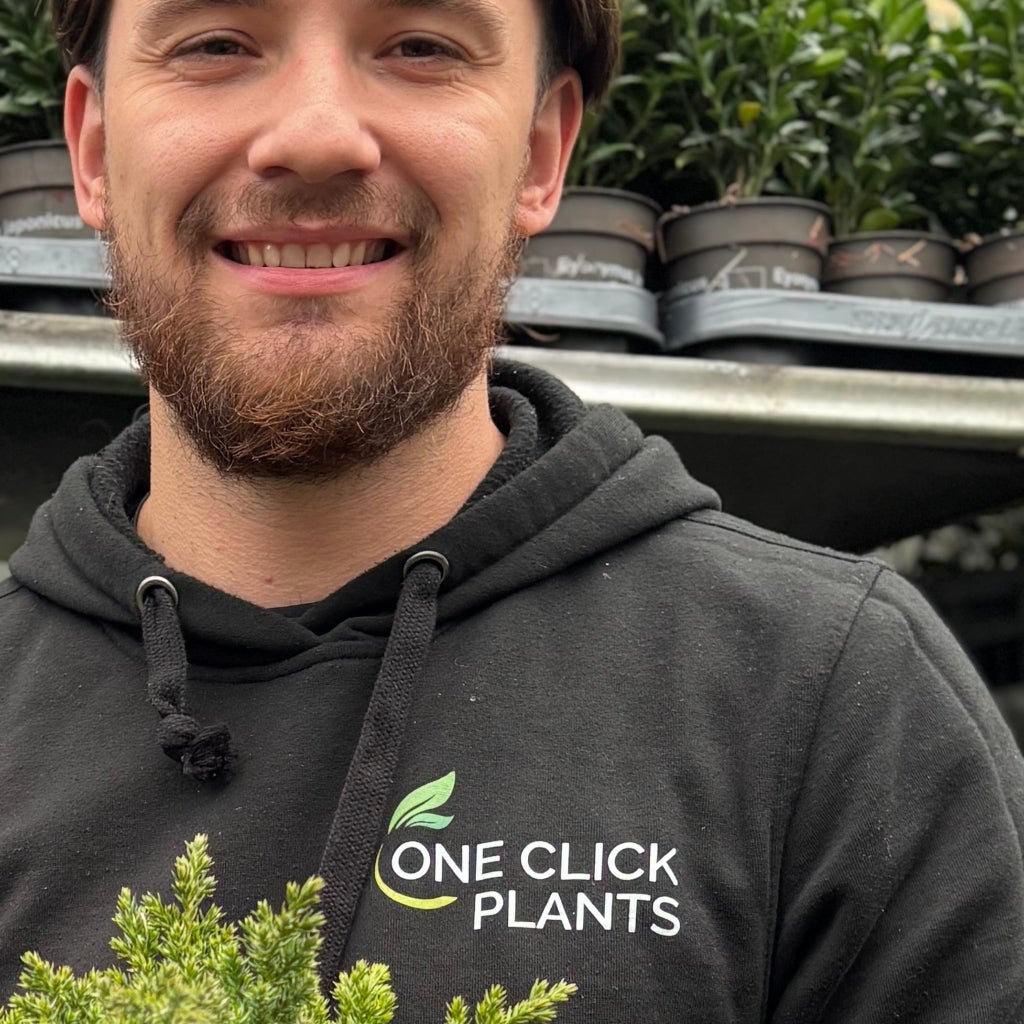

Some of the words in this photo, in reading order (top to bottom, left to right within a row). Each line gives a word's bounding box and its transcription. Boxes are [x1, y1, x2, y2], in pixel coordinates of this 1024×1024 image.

[391, 840, 505, 884] ONE
[520, 841, 678, 886] CLICK
[473, 889, 681, 937] PLANTS
